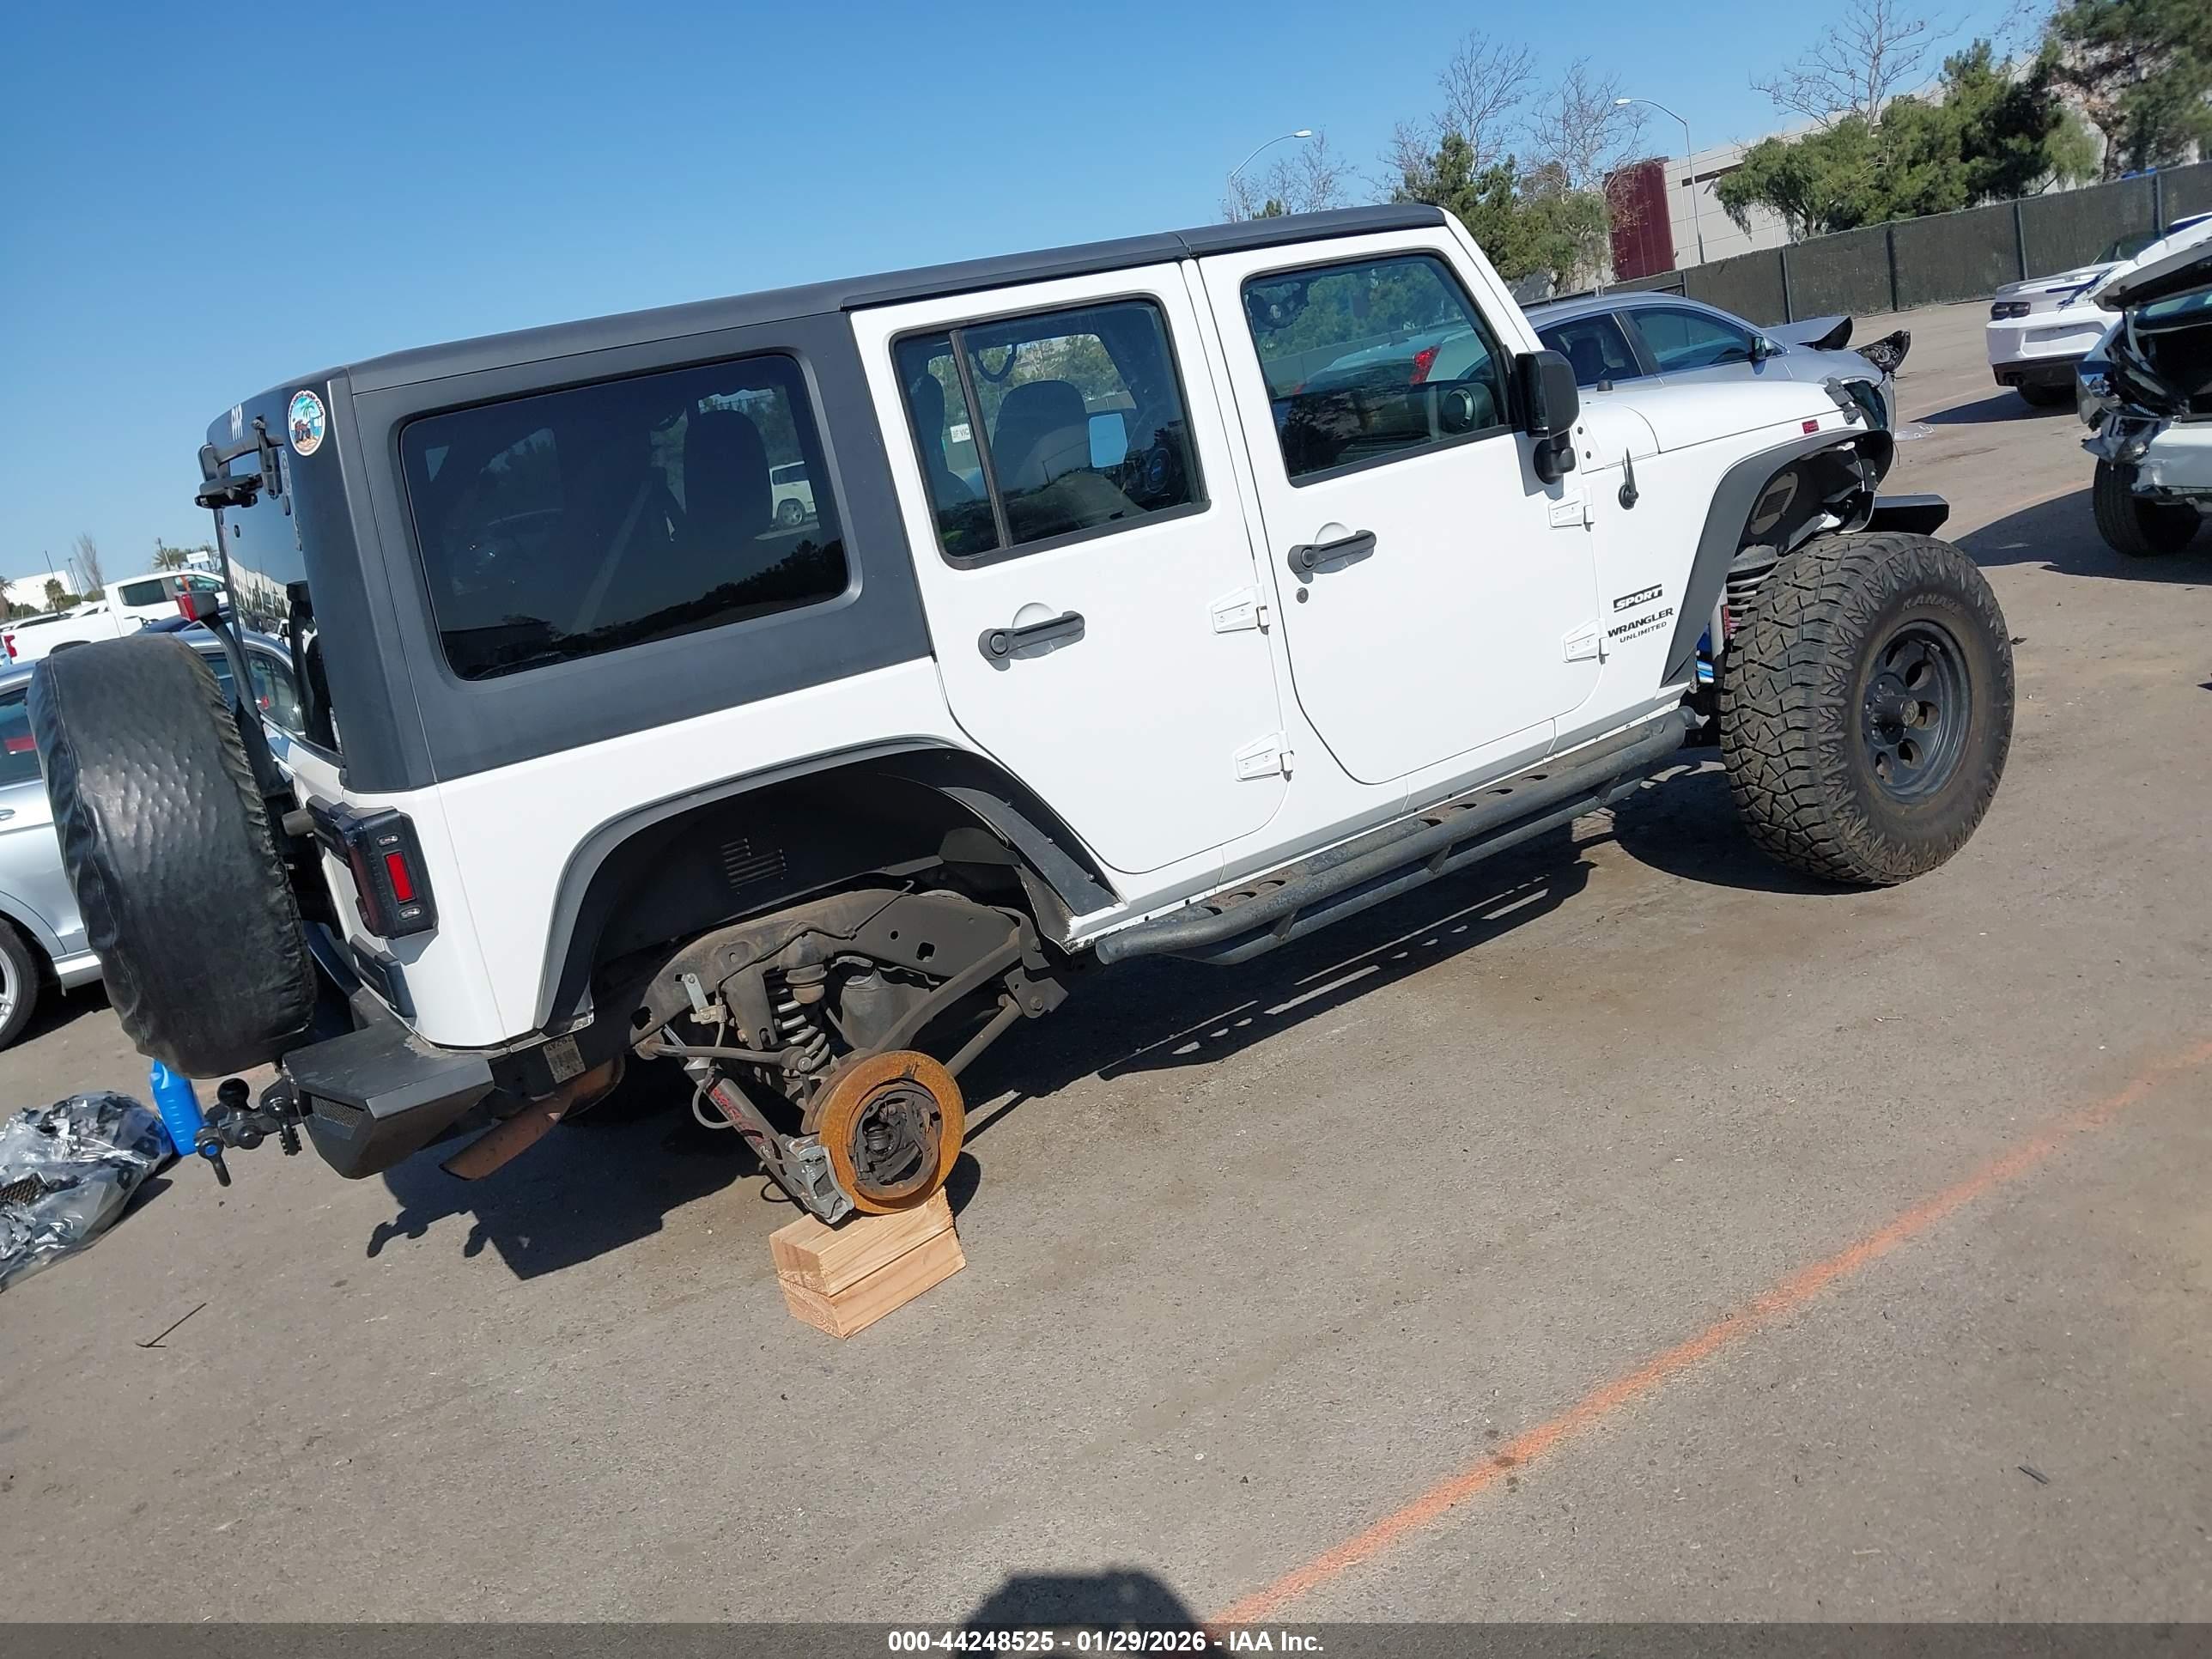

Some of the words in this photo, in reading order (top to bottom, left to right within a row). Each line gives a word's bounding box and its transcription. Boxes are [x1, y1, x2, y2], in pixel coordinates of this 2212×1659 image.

[1615, 587, 1662, 610] SPORT
[1607, 607, 1674, 638] WRANGLER
[1620, 621, 1667, 643] UNLIMITED
